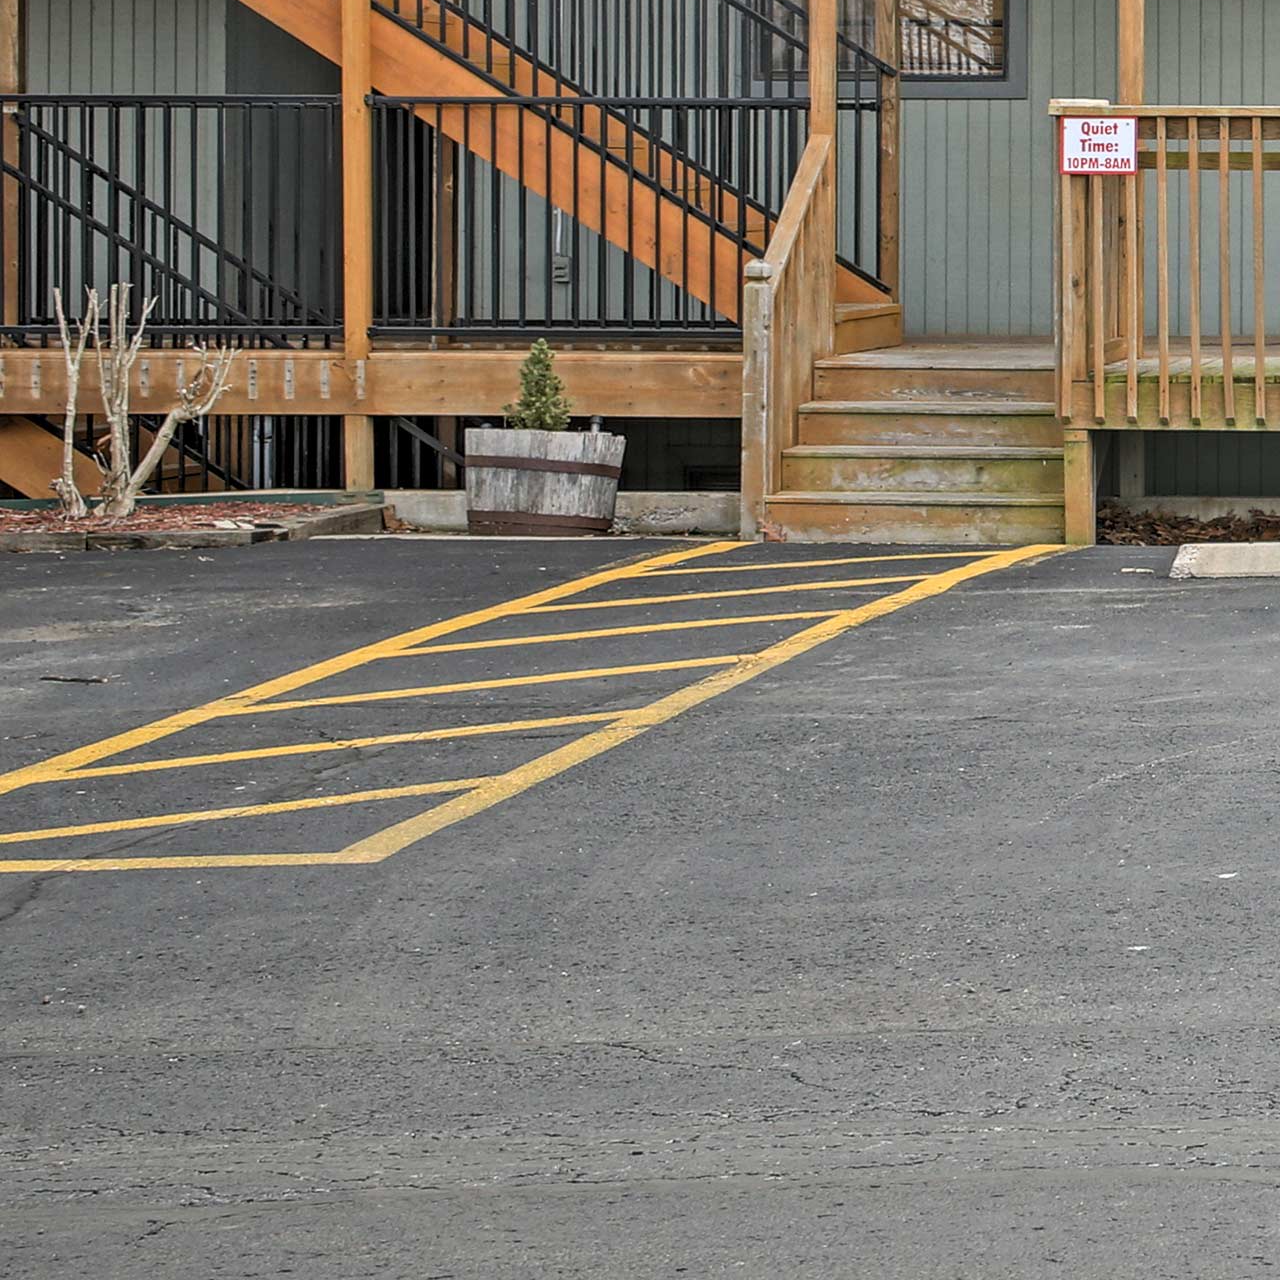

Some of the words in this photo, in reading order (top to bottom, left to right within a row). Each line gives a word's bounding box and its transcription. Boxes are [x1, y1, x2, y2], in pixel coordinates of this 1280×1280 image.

[1080, 120, 1119, 137] Quiet
[1079, 137, 1120, 153] Time:
[1066, 157, 1132, 170] 10PM-8AM
